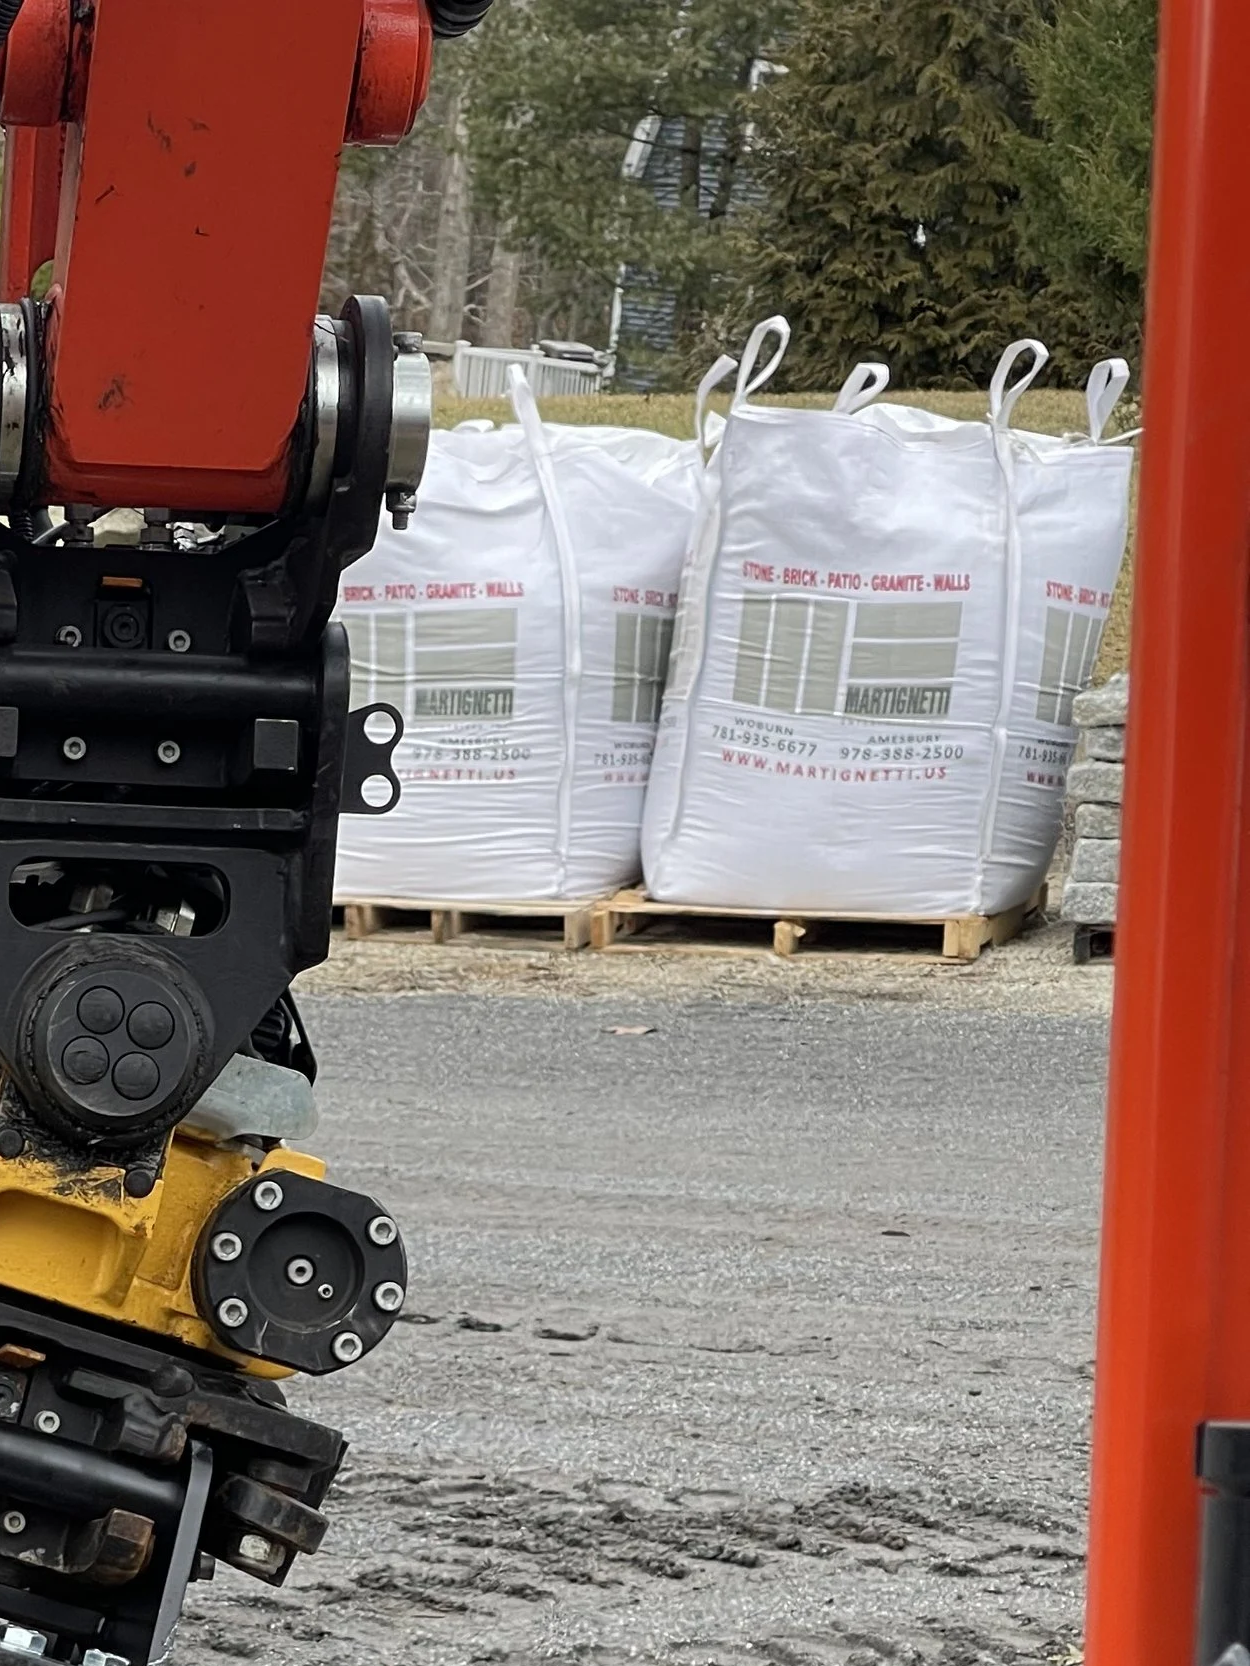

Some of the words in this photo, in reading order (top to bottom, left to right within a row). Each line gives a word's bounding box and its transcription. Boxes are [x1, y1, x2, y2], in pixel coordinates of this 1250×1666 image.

[742, 560, 774, 583] STONE
[783, 567, 818, 587] BRICK
[827, 571, 861, 590] PATIO
[871, 574, 924, 591] GRANITE
[933, 573, 970, 591] WALLS
[343, 585, 375, 601] BRICK
[385, 584, 416, 600] PATIO
[426, 582, 477, 599] GRANITE
[486, 581, 525, 597] WALLS
[1046, 580, 1073, 602] STONE
[844, 686, 951, 715] MARTIGNETTI
[735, 715, 794, 736] WOBURN
[712, 724, 817, 757] 781-935-6677
[867, 734, 942, 745] AMESBURY
[721, 746, 948, 782] WWW.MARTIGNETTI.US
[839, 745, 964, 761] 978-388-2500
